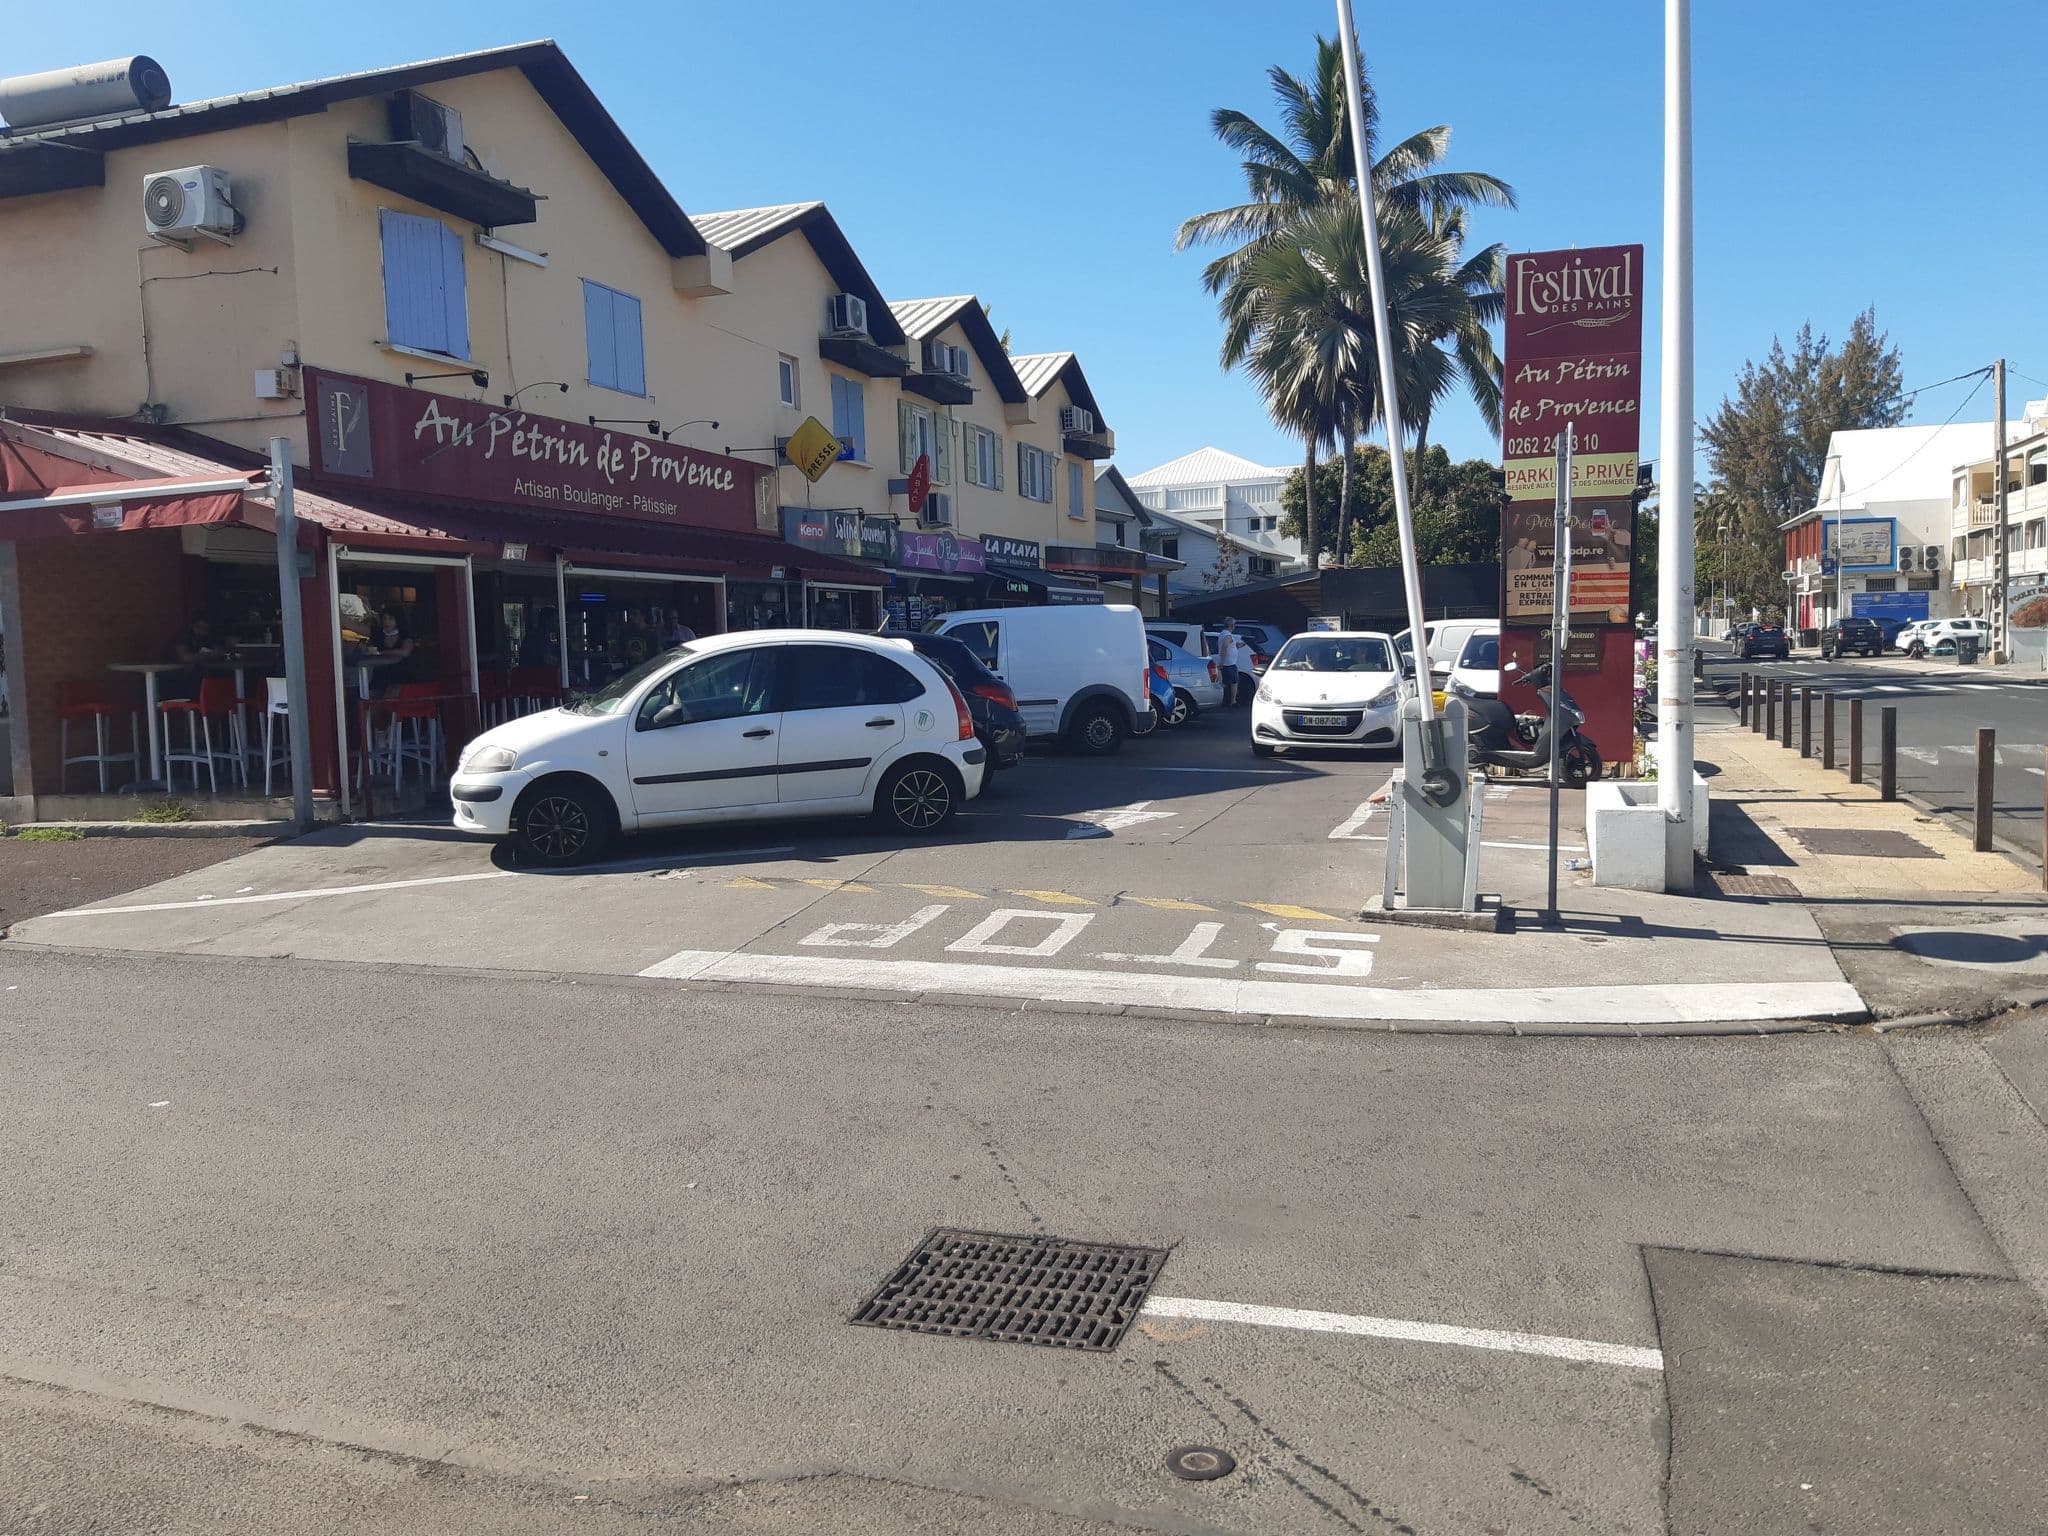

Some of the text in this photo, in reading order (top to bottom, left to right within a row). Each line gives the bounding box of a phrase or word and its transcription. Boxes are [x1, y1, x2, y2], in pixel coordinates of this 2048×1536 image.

[1515, 252, 1633, 315] Festival
[1551, 299, 1631, 313] DES PAINS
[1515, 359, 1630, 384] Au Pétrin
[1509, 398, 1636, 425] de Provence
[414, 399, 735, 491] Au Pétrin de Provence
[1508, 437, 1539, 455] 0262
[1584, 433, 1599, 450] 10
[807, 443, 837, 476] PRESSE
[1507, 465, 1580, 484] PARKIG
[1586, 459, 1634, 479] PRIVÉ
[911, 464, 924, 503] TABAC
[1593, 478, 1635, 486] COMMERCES
[514, 477, 559, 499] Artisan
[563, 485, 624, 511] Boulanger
[633, 496, 678, 515] Pâtissier
[800, 525, 823, 537] Keno
[835, 516, 858, 540] Saline
[985, 539, 999, 553] LA
[1003, 541, 1037, 558] PLAYA
[2009, 588, 2037, 604] POULET
[798, 905, 1381, 977] STOP
